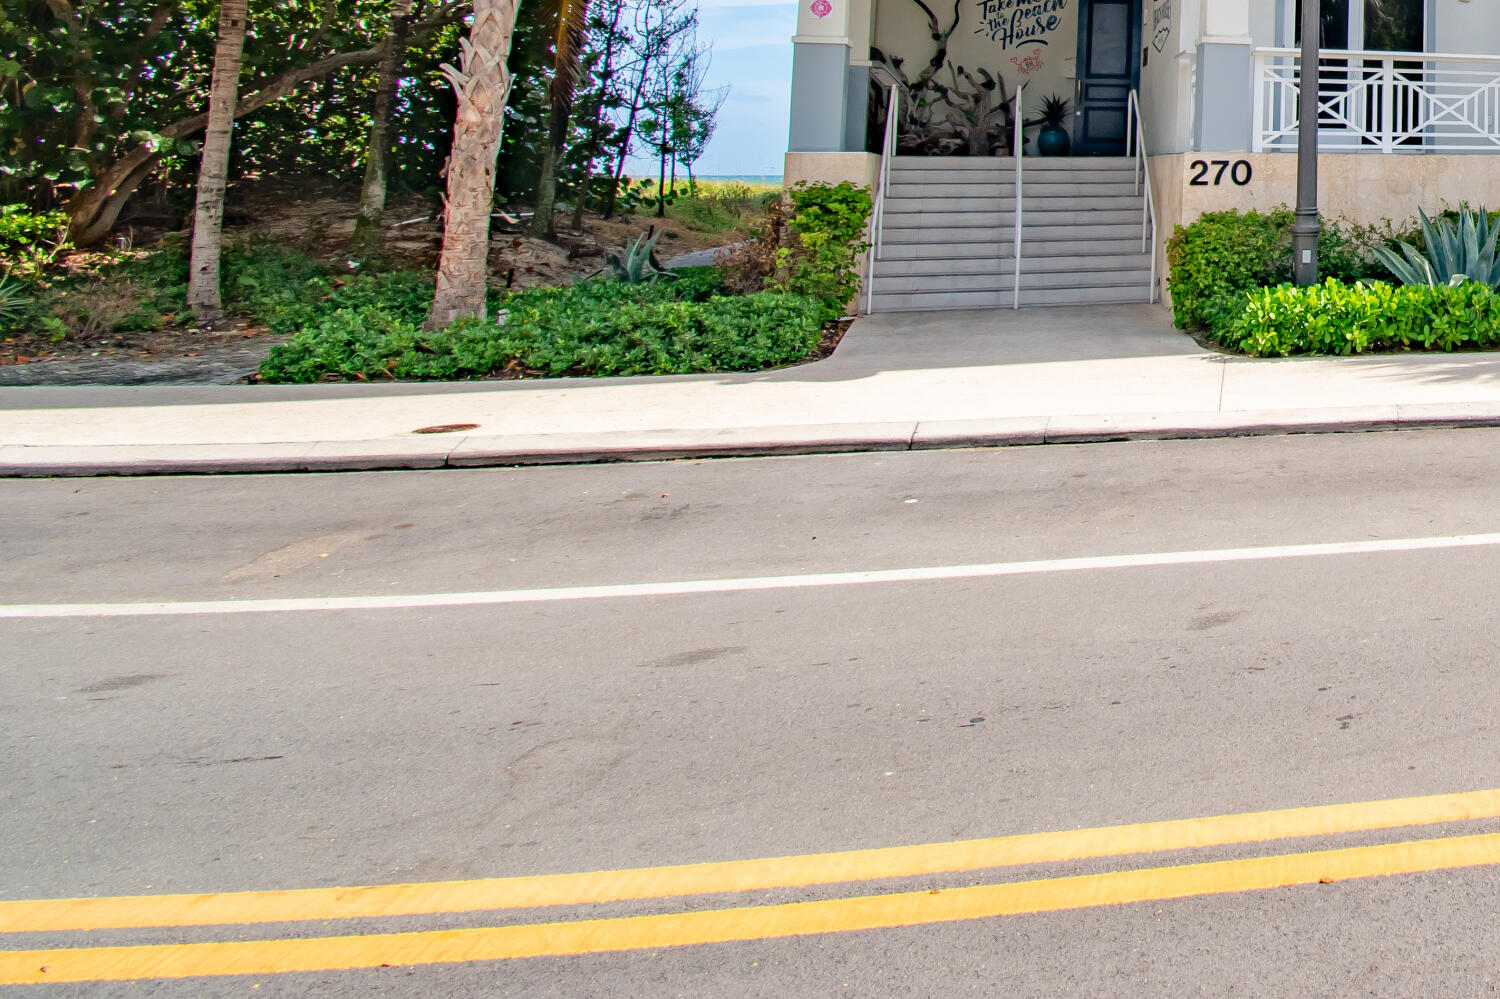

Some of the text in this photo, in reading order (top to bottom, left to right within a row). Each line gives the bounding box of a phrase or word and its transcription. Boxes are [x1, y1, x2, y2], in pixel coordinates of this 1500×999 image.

[987, 17, 1009, 31] the
[992, 15, 1062, 50] House
[1190, 160, 1252, 186] 270
